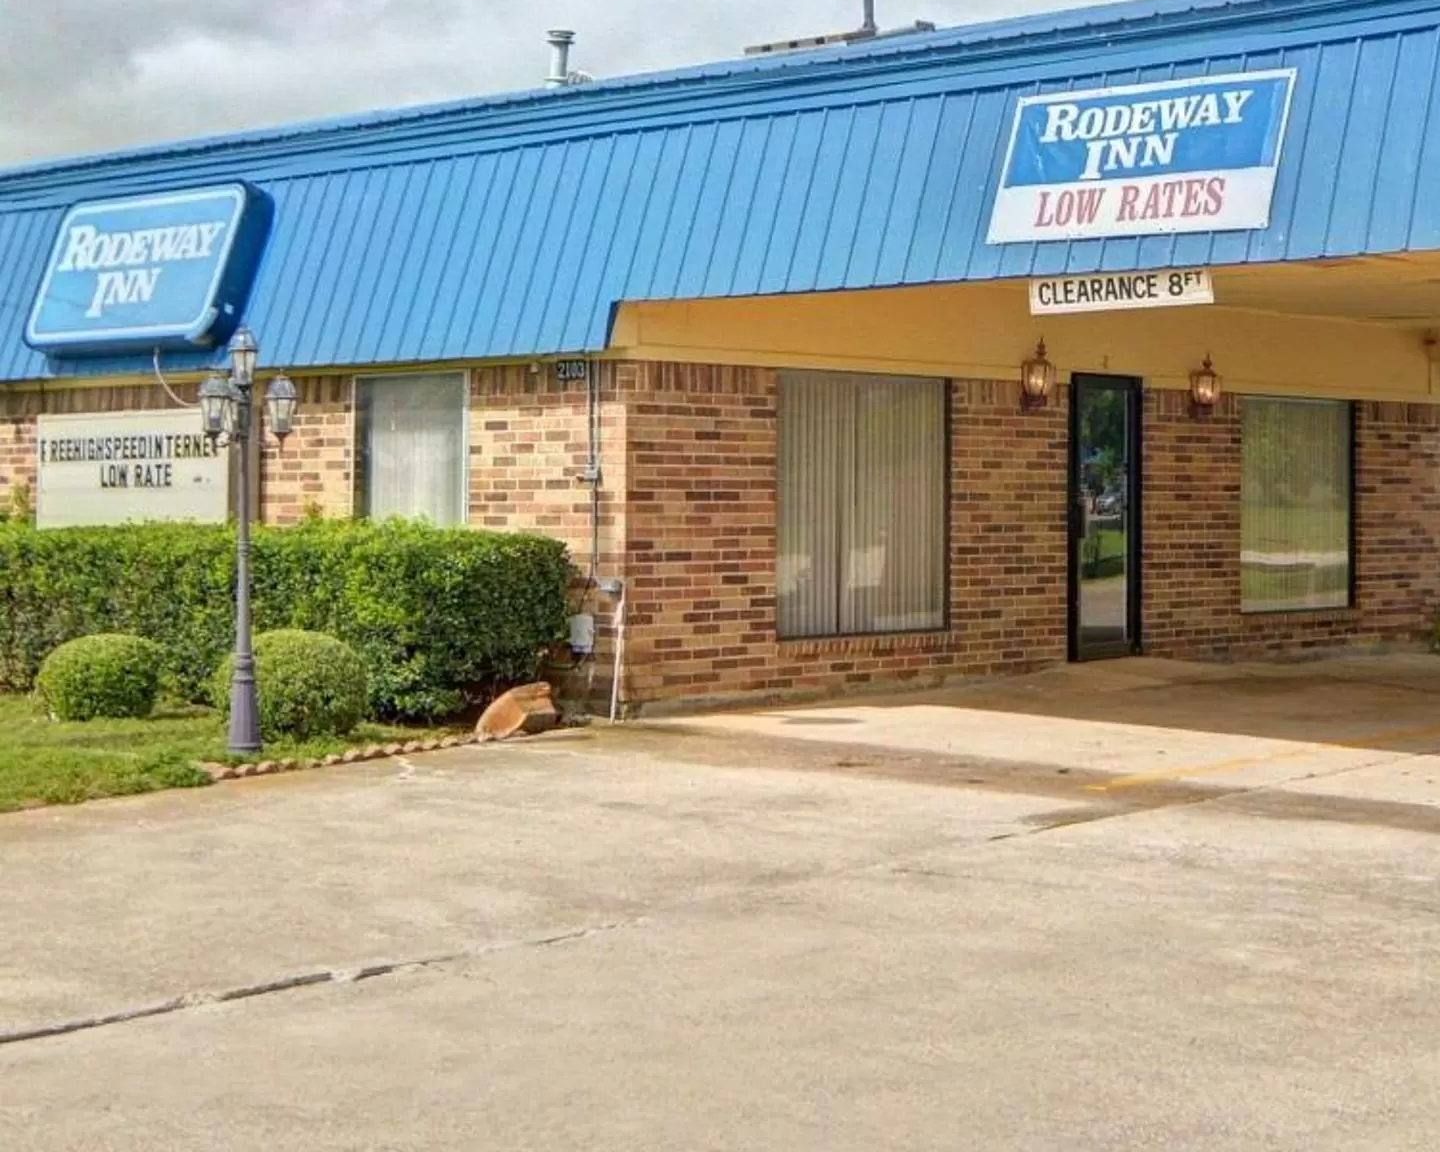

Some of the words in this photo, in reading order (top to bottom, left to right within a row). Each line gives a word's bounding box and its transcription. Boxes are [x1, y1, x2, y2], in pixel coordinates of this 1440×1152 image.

[1039, 90, 1254, 143] RODEWAY
[1079, 133, 1179, 180] INN
[1033, 188, 1106, 227] LOW
[1116, 177, 1226, 222] RATES
[56, 221, 226, 272] RODEWAY
[84, 267, 162, 319] INN
[1038, 274, 1159, 306] CLEARANCE
[101, 465, 128, 489] LOW
[134, 463, 172, 488] RATE
